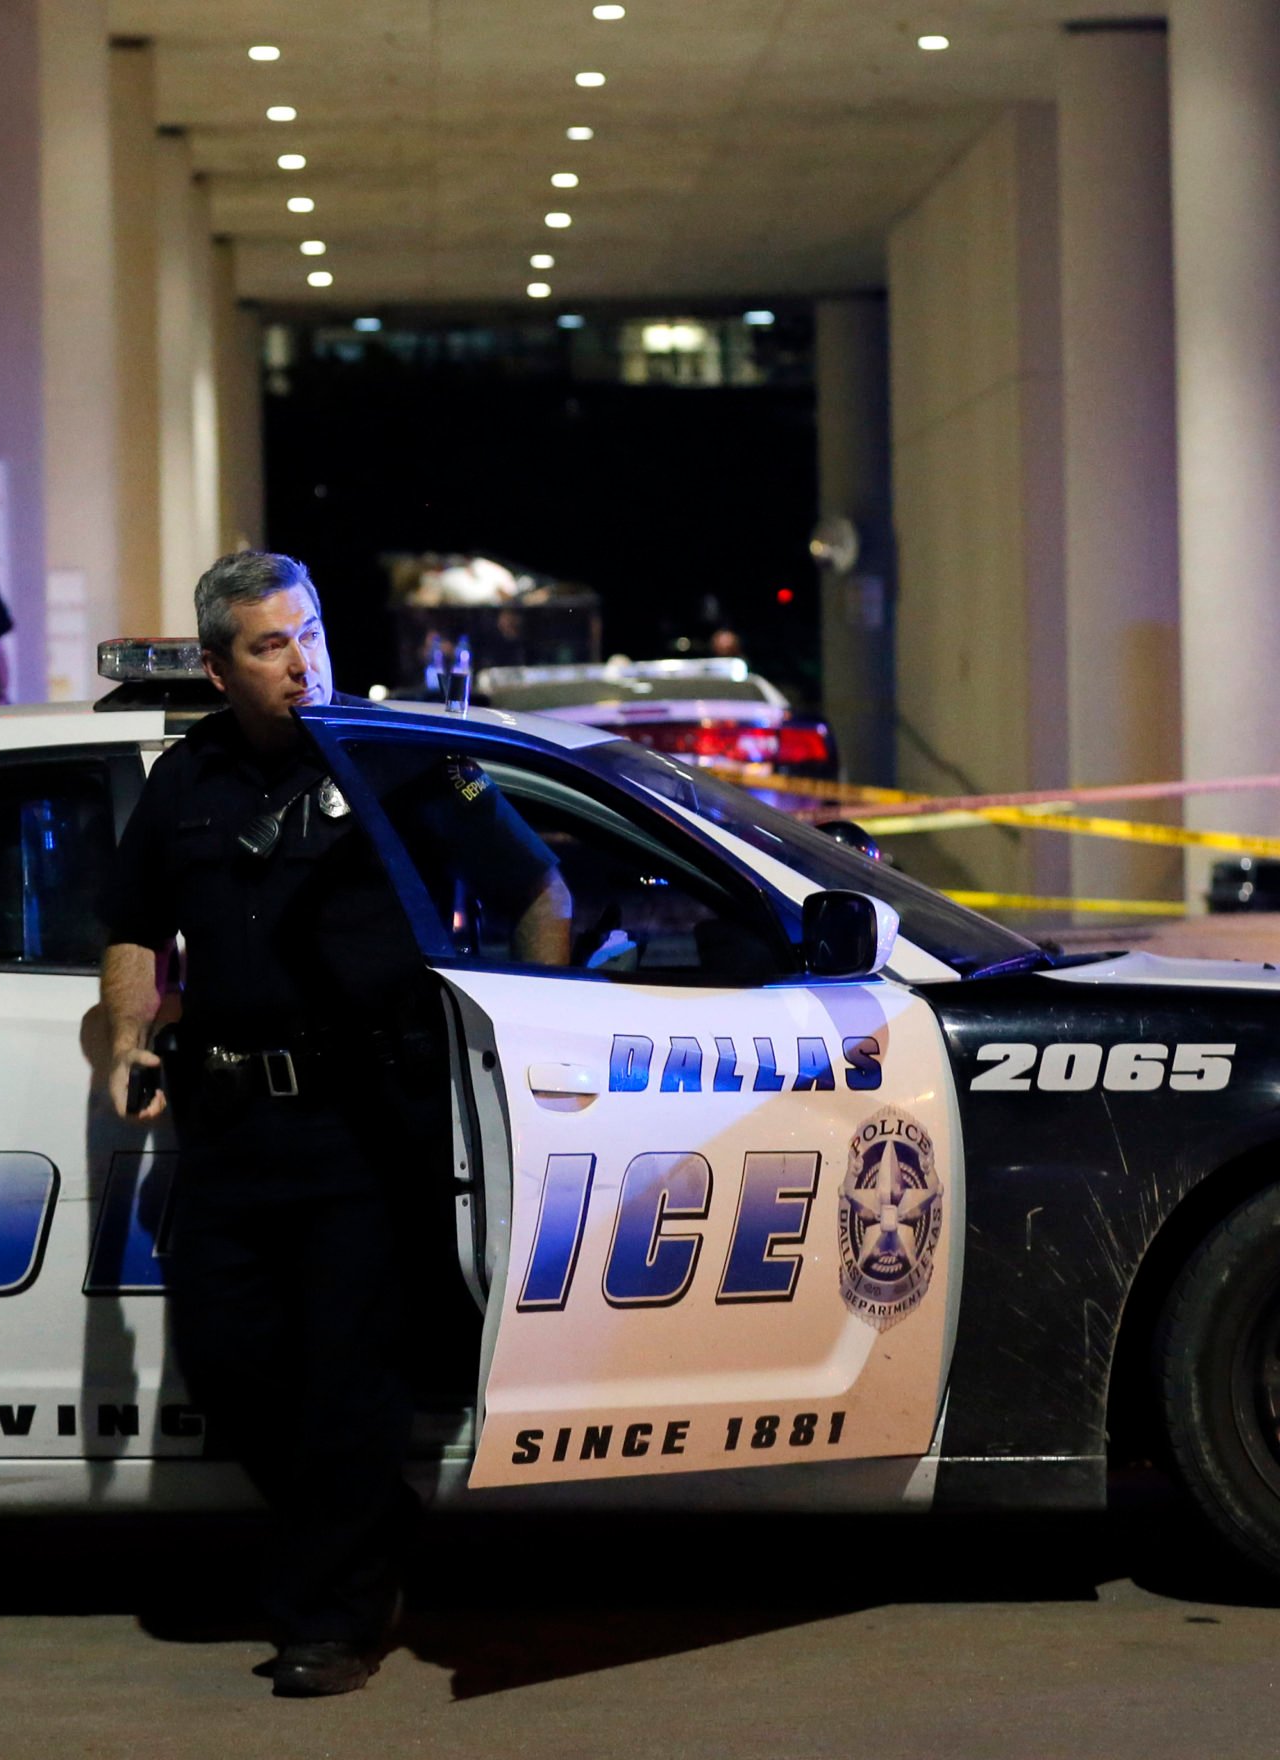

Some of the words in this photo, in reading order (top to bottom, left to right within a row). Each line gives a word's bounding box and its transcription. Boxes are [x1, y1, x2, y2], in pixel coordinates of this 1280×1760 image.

[609, 1034, 882, 1092] DALLAS
[970, 1043, 1236, 1091] 2065
[850, 1119, 932, 1155] POLICE
[516, 1151, 822, 1312] ICE
[838, 1208, 861, 1282] DALLAS
[913, 1207, 942, 1280] TEXAS
[845, 1289, 923, 1317] DEPARTMENT
[511, 1420, 691, 1464] SINCE
[723, 1411, 846, 1451] 1881
